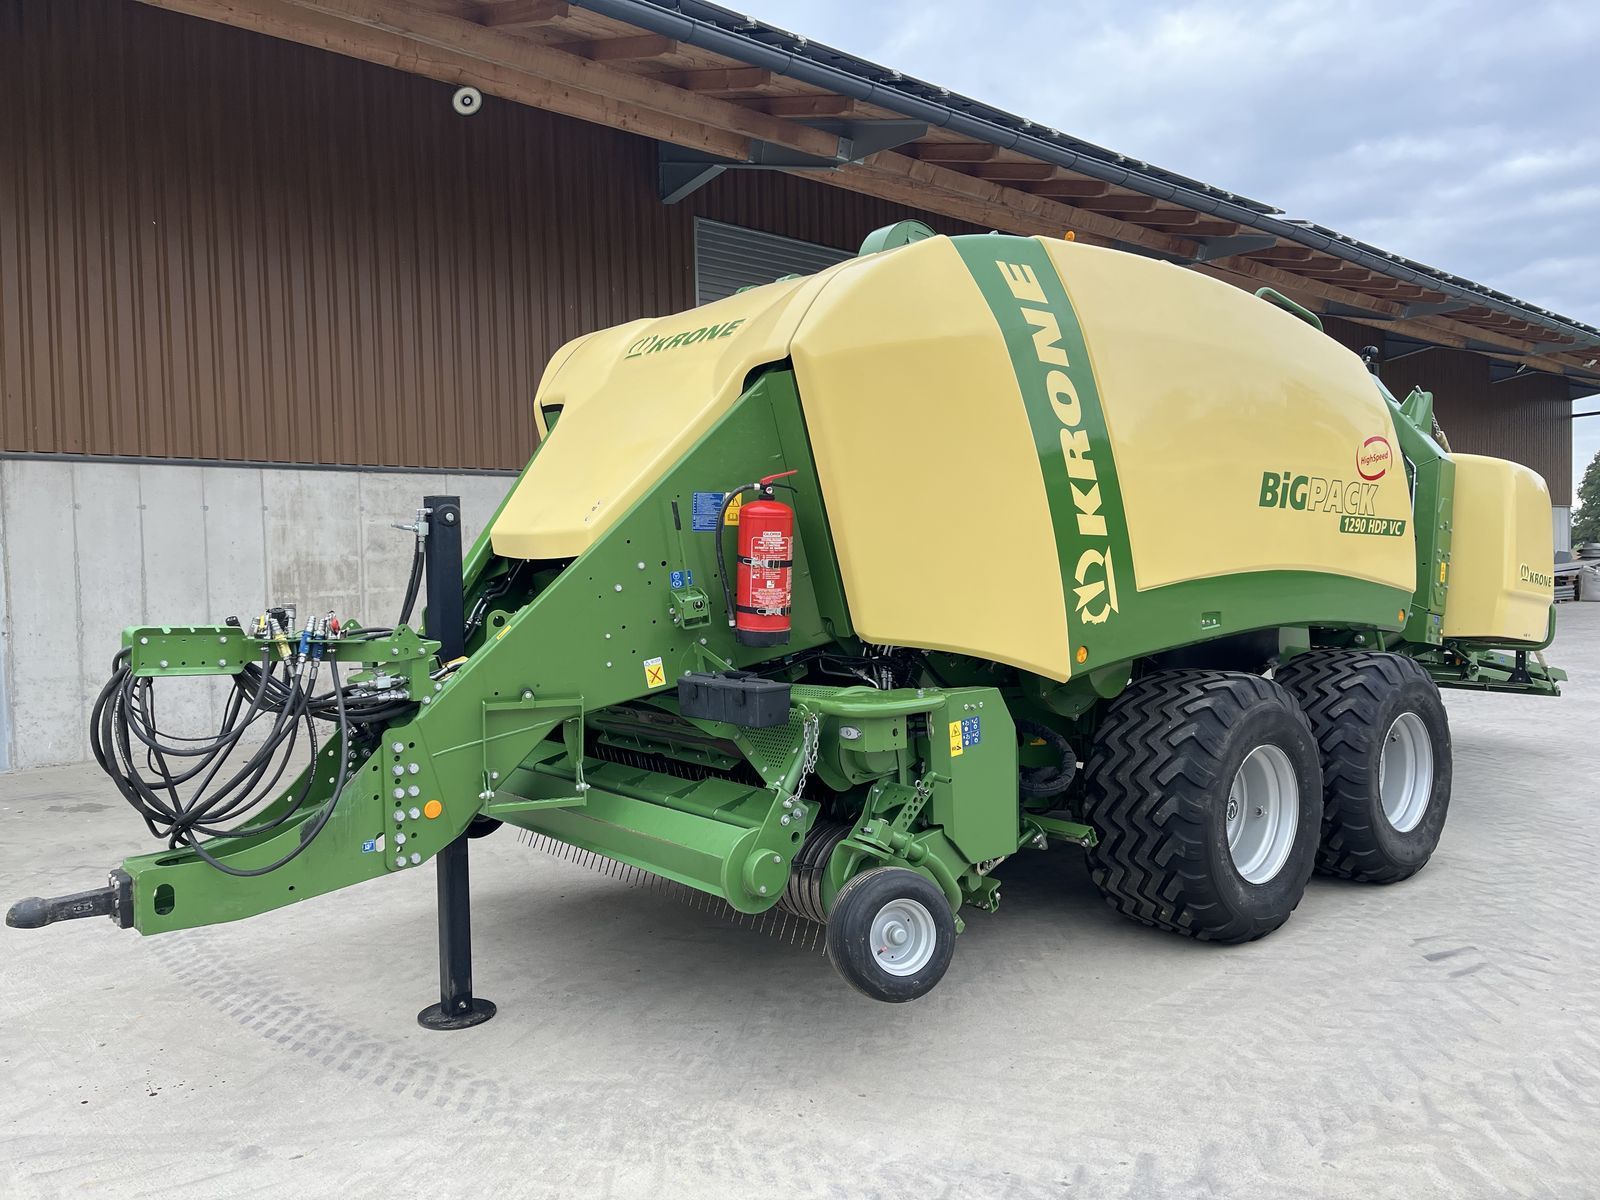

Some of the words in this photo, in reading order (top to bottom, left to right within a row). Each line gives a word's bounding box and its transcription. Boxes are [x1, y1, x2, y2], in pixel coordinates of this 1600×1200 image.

[646, 318, 747, 354] KRONE
[995, 260, 1108, 536] KRONE
[1360, 450, 1389, 466] HighSpeed
[1344, 517, 1366, 533] 1290
[1368, 518, 1388, 535] HDP
[1389, 520, 1403, 535] VC
[1529, 571, 1552, 588] KRONE
